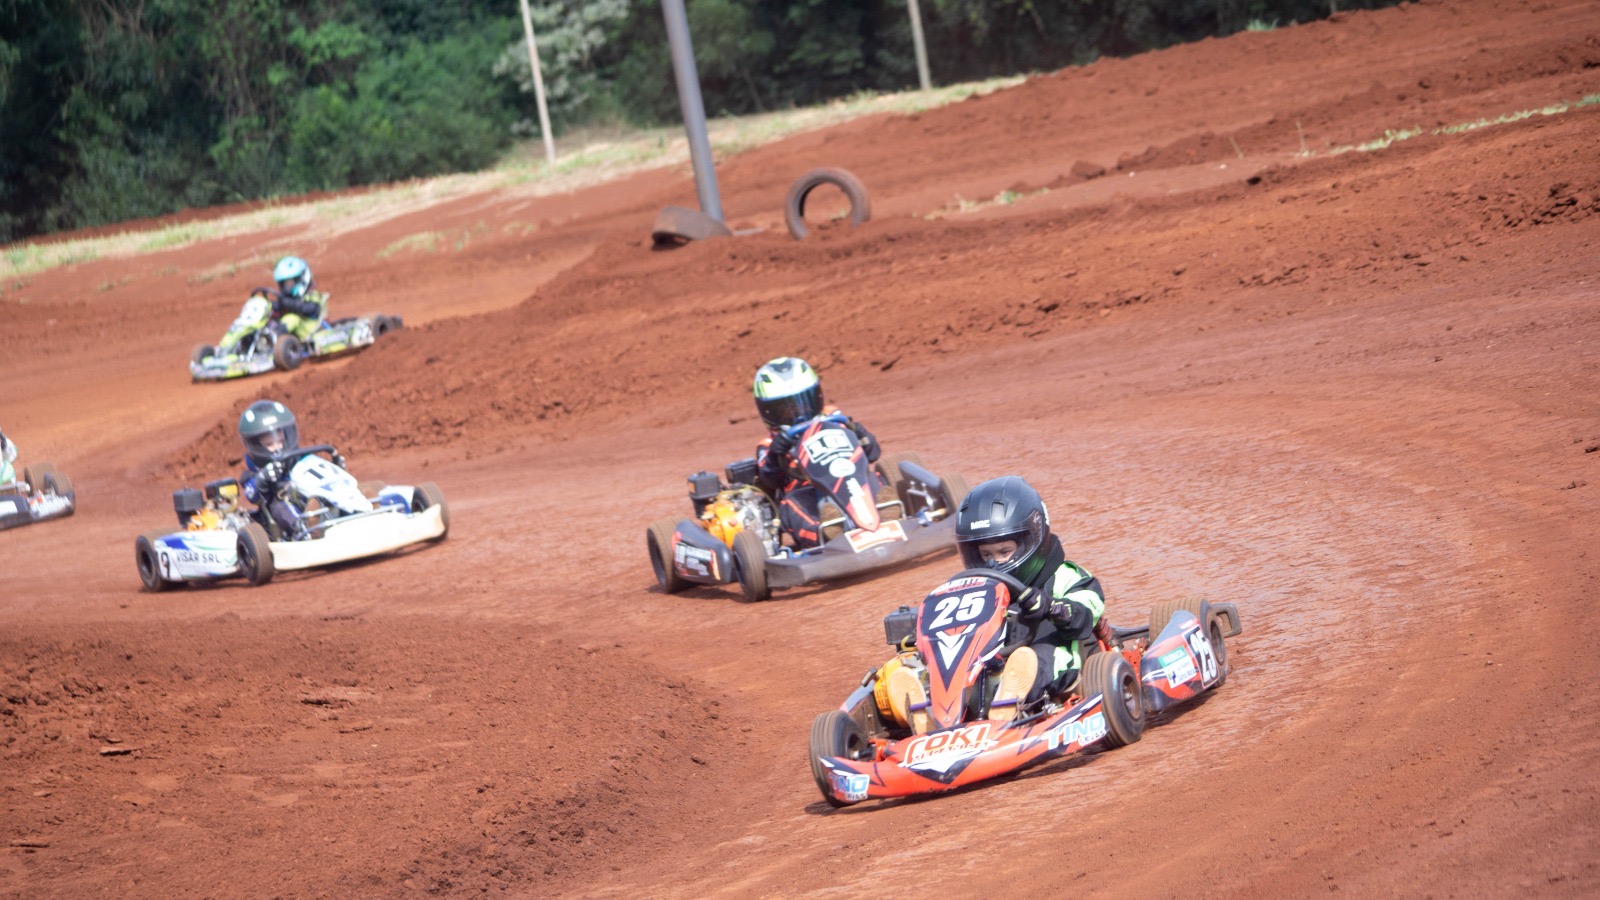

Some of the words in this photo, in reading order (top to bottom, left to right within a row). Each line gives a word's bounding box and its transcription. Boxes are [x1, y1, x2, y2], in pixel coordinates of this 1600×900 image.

[161, 551, 171, 579] 9
[202, 552, 222, 563] SRL
[928, 590, 987, 630] 25
[1189, 629, 1217, 683] 25
[1048, 713, 1106, 748] TINO
